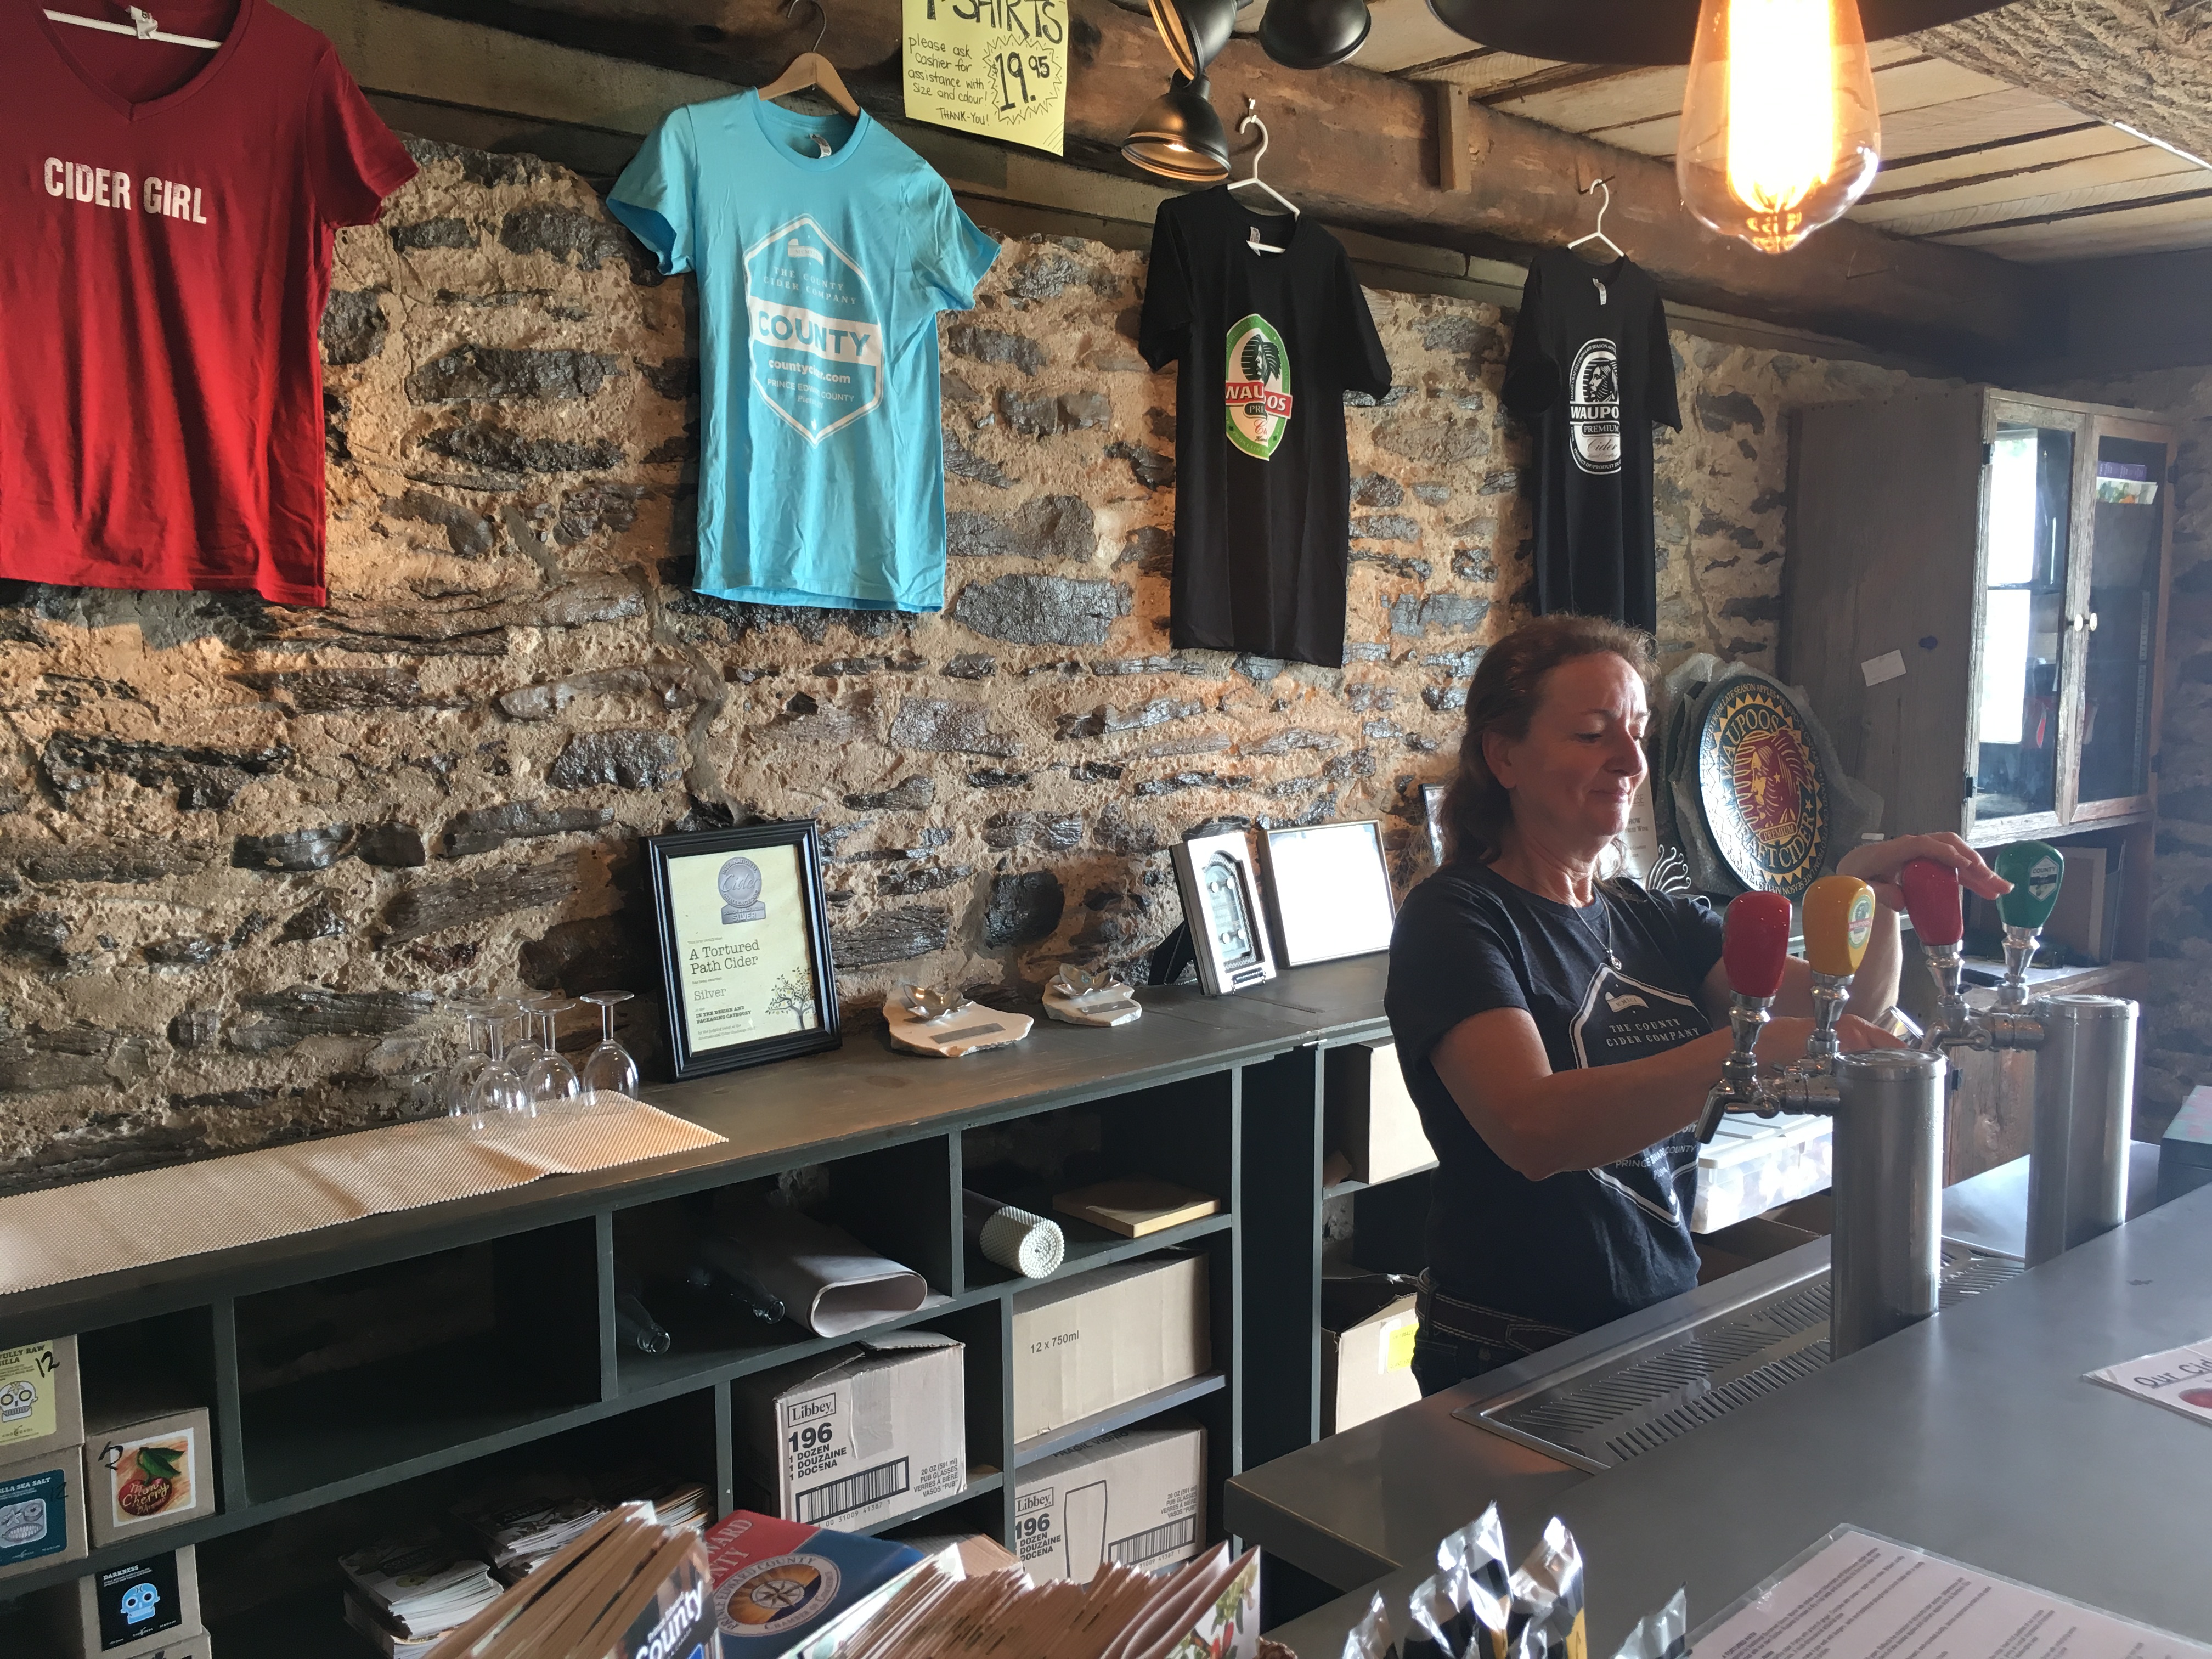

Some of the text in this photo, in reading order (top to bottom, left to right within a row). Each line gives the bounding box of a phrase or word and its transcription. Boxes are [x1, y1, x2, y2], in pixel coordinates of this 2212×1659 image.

[908, 33, 972, 59] please ask
[955, 58, 972, 72] for
[907, 69, 984, 90] assistance with
[937, 88, 955, 100] and
[44, 157, 207, 224] CIDER GIRL
[773, 266, 843, 291] THE COUNTY
[763, 276, 856, 304] CIDER COMPANY
[758, 310, 871, 357] COUNTY
[768, 359, 850, 384] countycier.com
[767, 379, 854, 402] PRINCE COUNTY
[1587, 438, 1618, 452] Cider
[1710, 703, 1724, 726] FROM
[1722, 690, 1735, 706] LATE
[1734, 683, 1756, 696] SEASON
[1757, 685, 1777, 699] APPLES
[1721, 708, 1779, 780] WAUPOOS
[1763, 825, 1795, 841] PREMIUM
[1779, 812, 1814, 867] CIDER
[720, 873, 761, 892] Cider
[732, 912, 757, 922] SILVER
[689, 939, 760, 960] A Tortured
[690, 956, 758, 975] Path Cider
[693, 988, 727, 1001] Silver
[696, 1010, 752, 1024] PACKAGING CATEGORY
[1609, 1018, 1680, 1034] THE COUNTY
[1606, 1027, 1700, 1047] CIDER COMPANY
[1615, 1144, 1696, 1169] PRINCE COUNTY
[26, 1344, 45, 1355] RAW
[1030, 1330, 1079, 1353] 12 x 750ml
[35, 1351, 60, 1378] 12
[2133, 1372, 2179, 1386] Our
[792, 1401, 833, 1421] Libbey
[788, 1422, 832, 1453] 196
[1092, 1431, 1129, 1445] VIDRIO
[789, 1443, 830, 1463] 1 DOZEN
[798, 1447, 847, 1470] DOUZAINE
[798, 1459, 838, 1479] DOCENA
[920, 1465, 958, 1483] PUB GLASSES
[921, 1468, 928, 1476] 20
[16, 1477, 51, 1490] SEA SALT
[913, 1480, 936, 1493] VERRES
[923, 1486, 941, 1497] VASOS
[1017, 1494, 1051, 1513] Libbey
[1166, 1491, 1198, 1506] PUB GLASSES
[826, 1519, 834, 1527] 00
[838, 1510, 859, 1523] 31009
[863, 1502, 883, 1513] 41387
[1161, 1503, 1179, 1515] VERRES
[1167, 1509, 1183, 1519] VASOS
[1015, 1513, 1050, 1540] 196
[1020, 1531, 1047, 1547] DOZEN
[1020, 1534, 1062, 1555] DOUZAINE
[1020, 1545, 1053, 1562] DOCENA
[103, 1565, 139, 1581] DARKNESS
[758, 1557, 817, 1571] COUNTY
